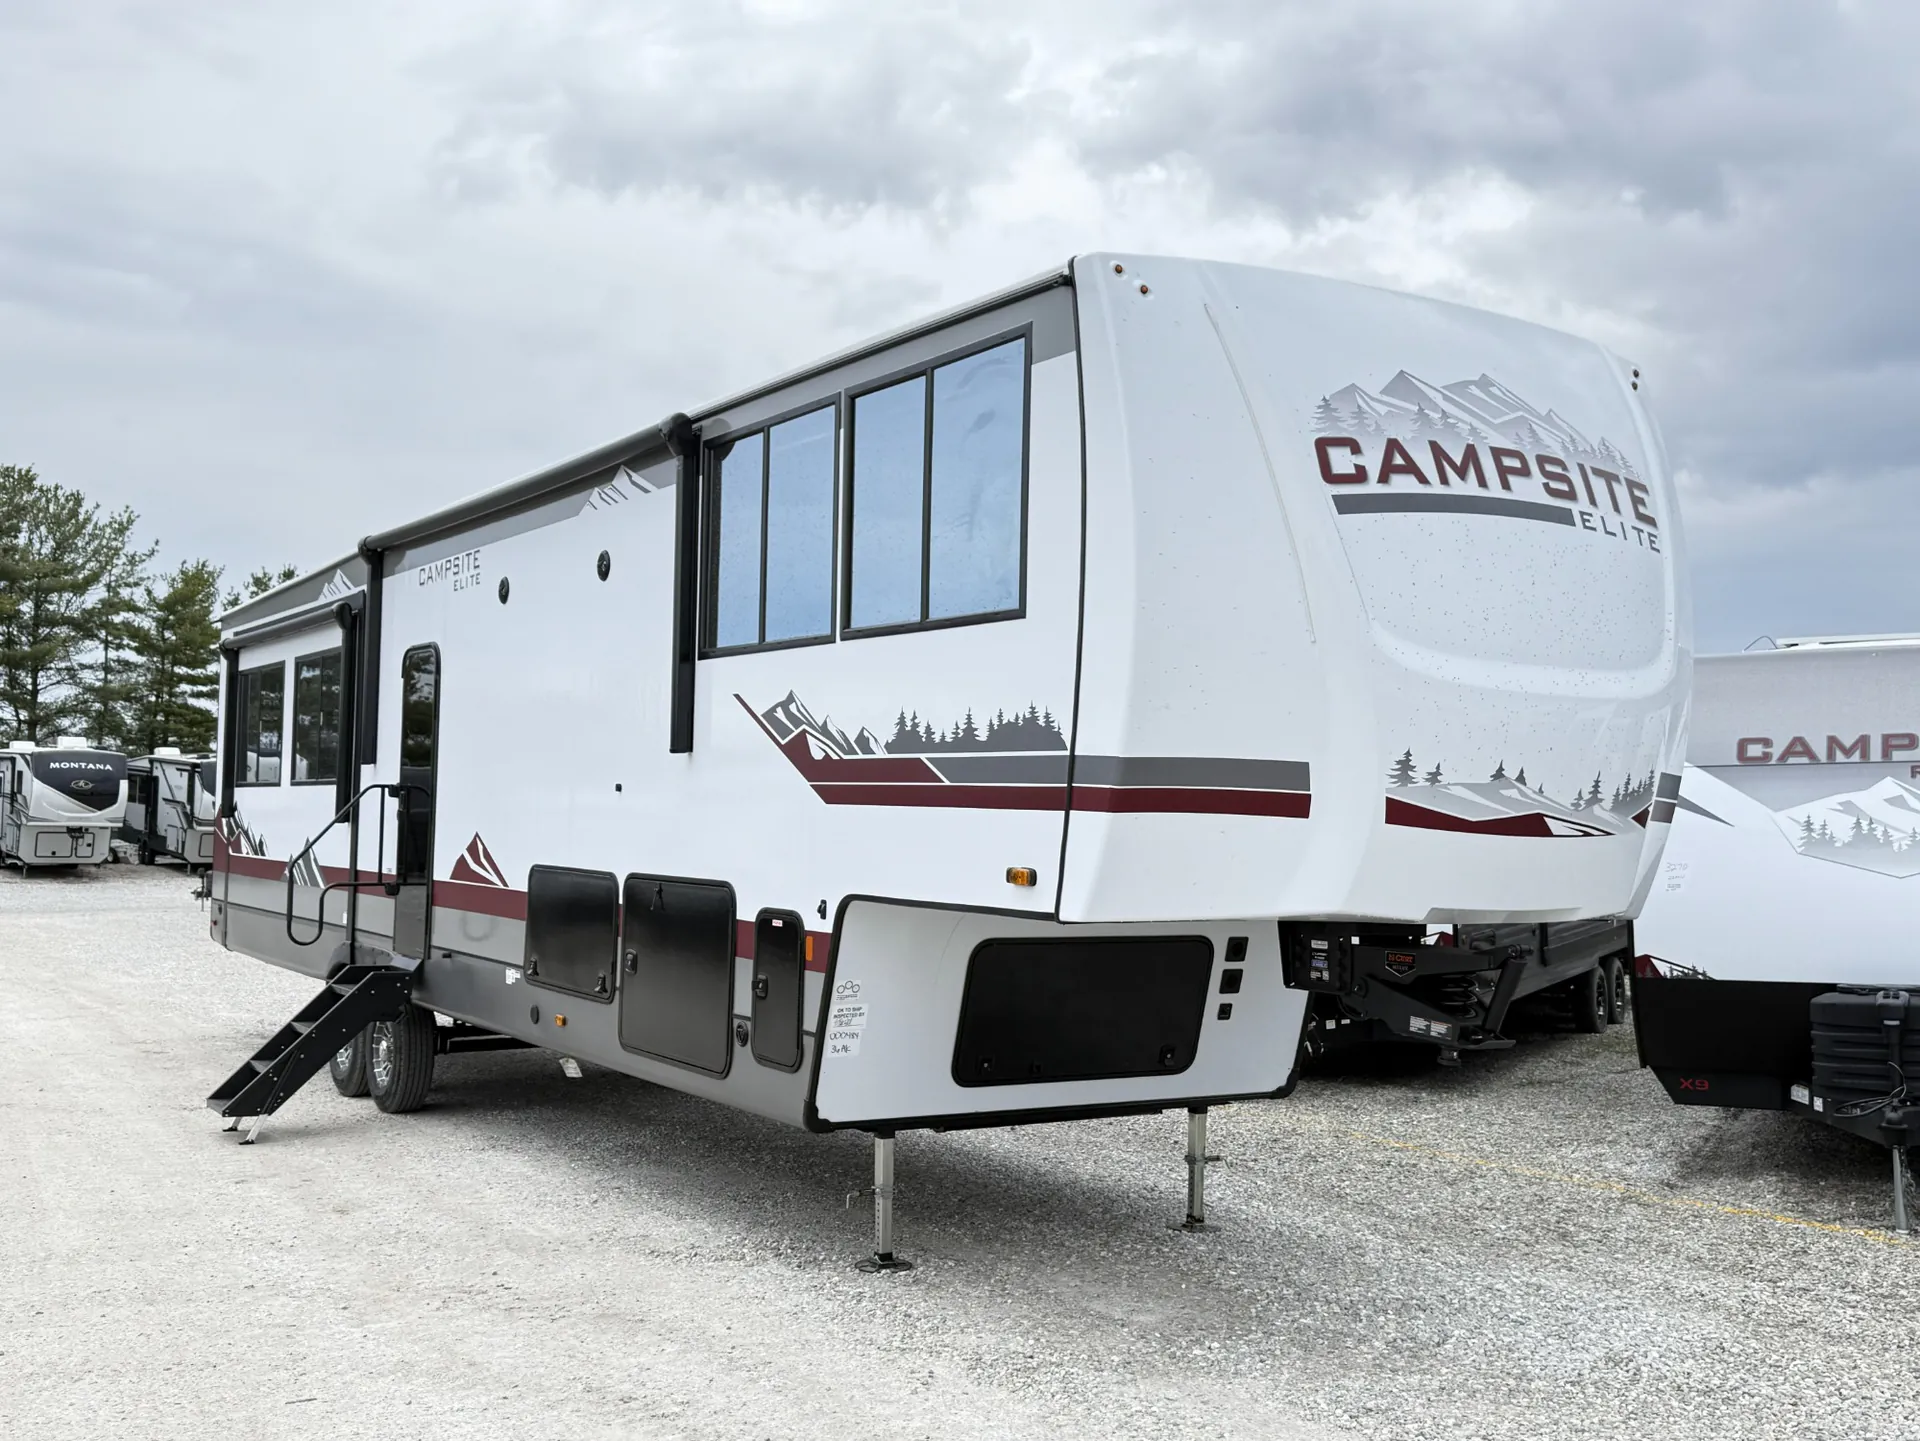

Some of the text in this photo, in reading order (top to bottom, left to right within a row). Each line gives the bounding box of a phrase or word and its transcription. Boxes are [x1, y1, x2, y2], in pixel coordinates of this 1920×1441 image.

[1314, 436, 1658, 529] CAMPSITE
[1580, 512, 1661, 554] ELITE
[419, 549, 480, 586] CAMPSITE
[453, 572, 481, 592] ELITE
[1736, 732, 1919, 764] CAMP
[50, 761, 113, 771] MONTANA
[1679, 1078, 1709, 1090] X9
